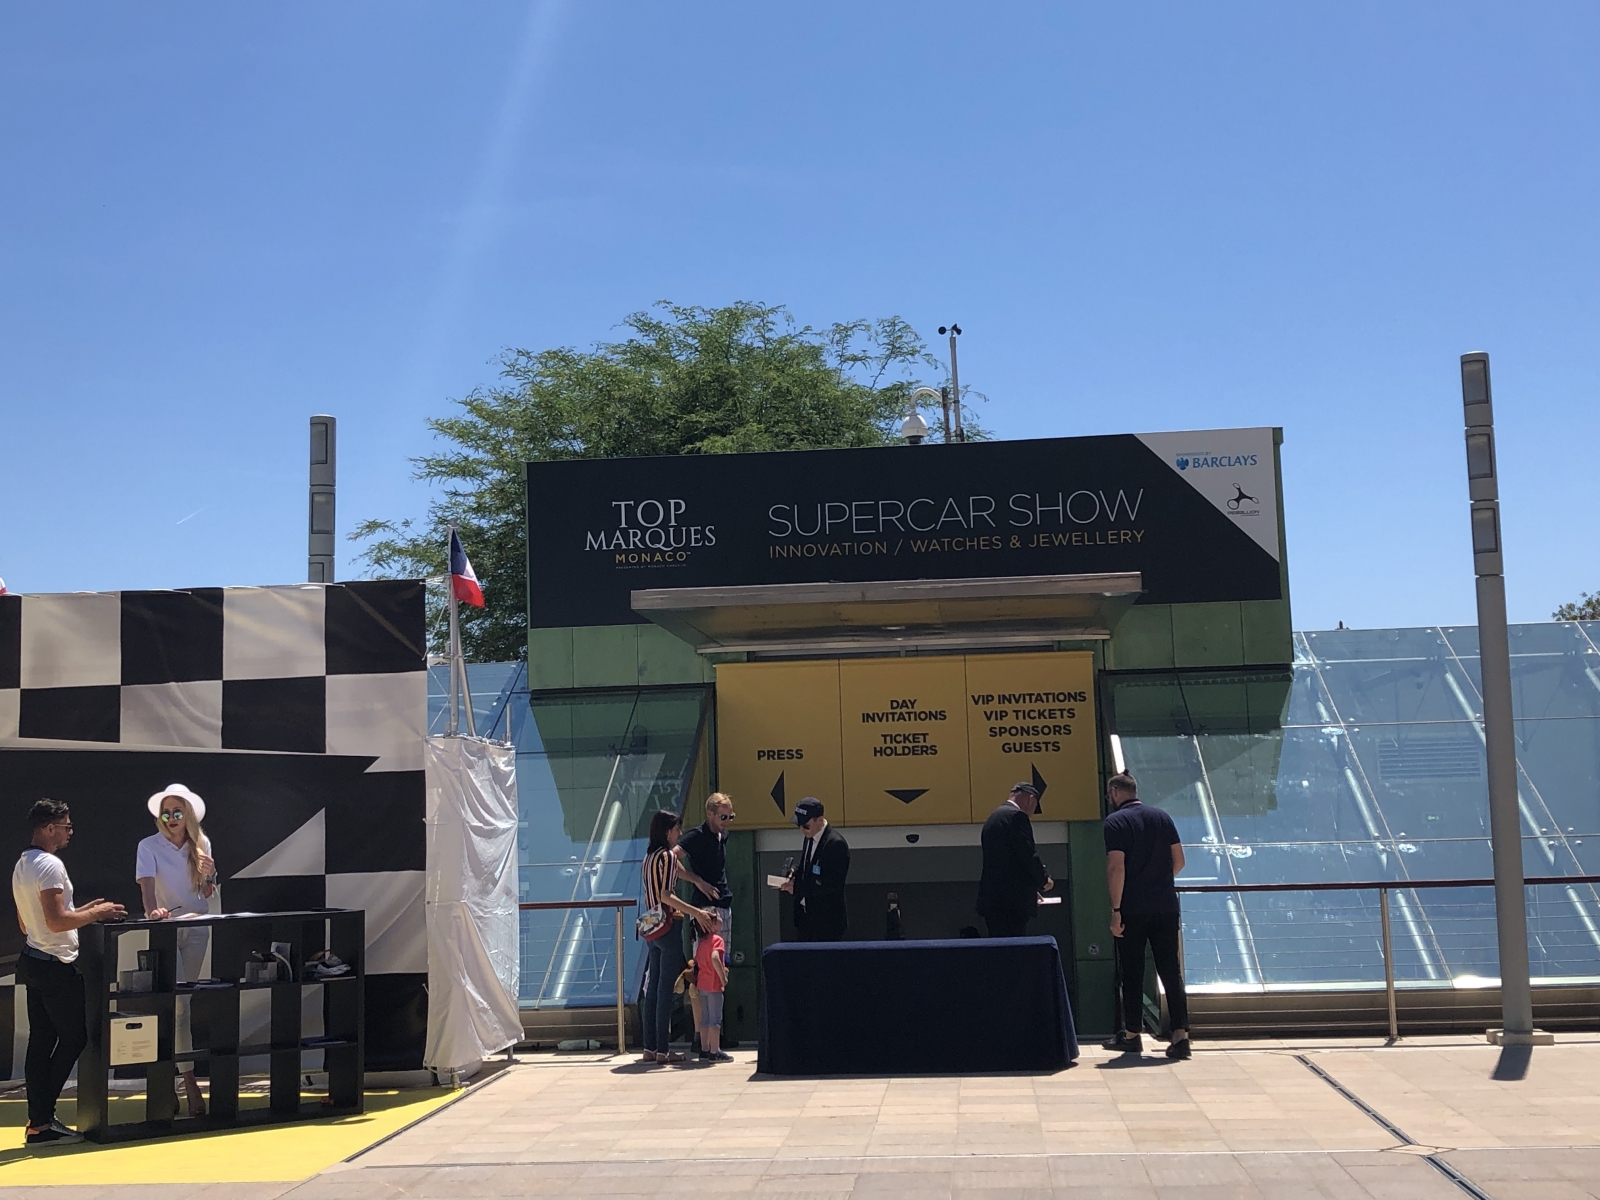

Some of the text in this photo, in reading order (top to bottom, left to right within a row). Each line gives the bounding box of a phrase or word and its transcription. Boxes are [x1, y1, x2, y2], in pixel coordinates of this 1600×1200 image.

[1193, 455, 1257, 468] BARCLAYS
[612, 499, 686, 528] TOP
[769, 489, 1144, 538] SUPERCAR SHOW
[584, 525, 716, 551] MARQUES
[770, 529, 1145, 558] INNOVATION / WATCHES & JEWELLERY
[616, 551, 686, 563] MONACO
[890, 699, 917, 710] DAY
[971, 691, 1087, 706] VIP INVITATIONS
[862, 709, 947, 723] INVITATIONS
[983, 707, 1075, 721] VIP TICKETS
[988, 724, 1072, 738] SPONSORS
[881, 733, 929, 744] TICKET
[873, 744, 938, 757] HOLDERS
[1001, 741, 1061, 753] GUESTS
[757, 748, 804, 761] PRESS
